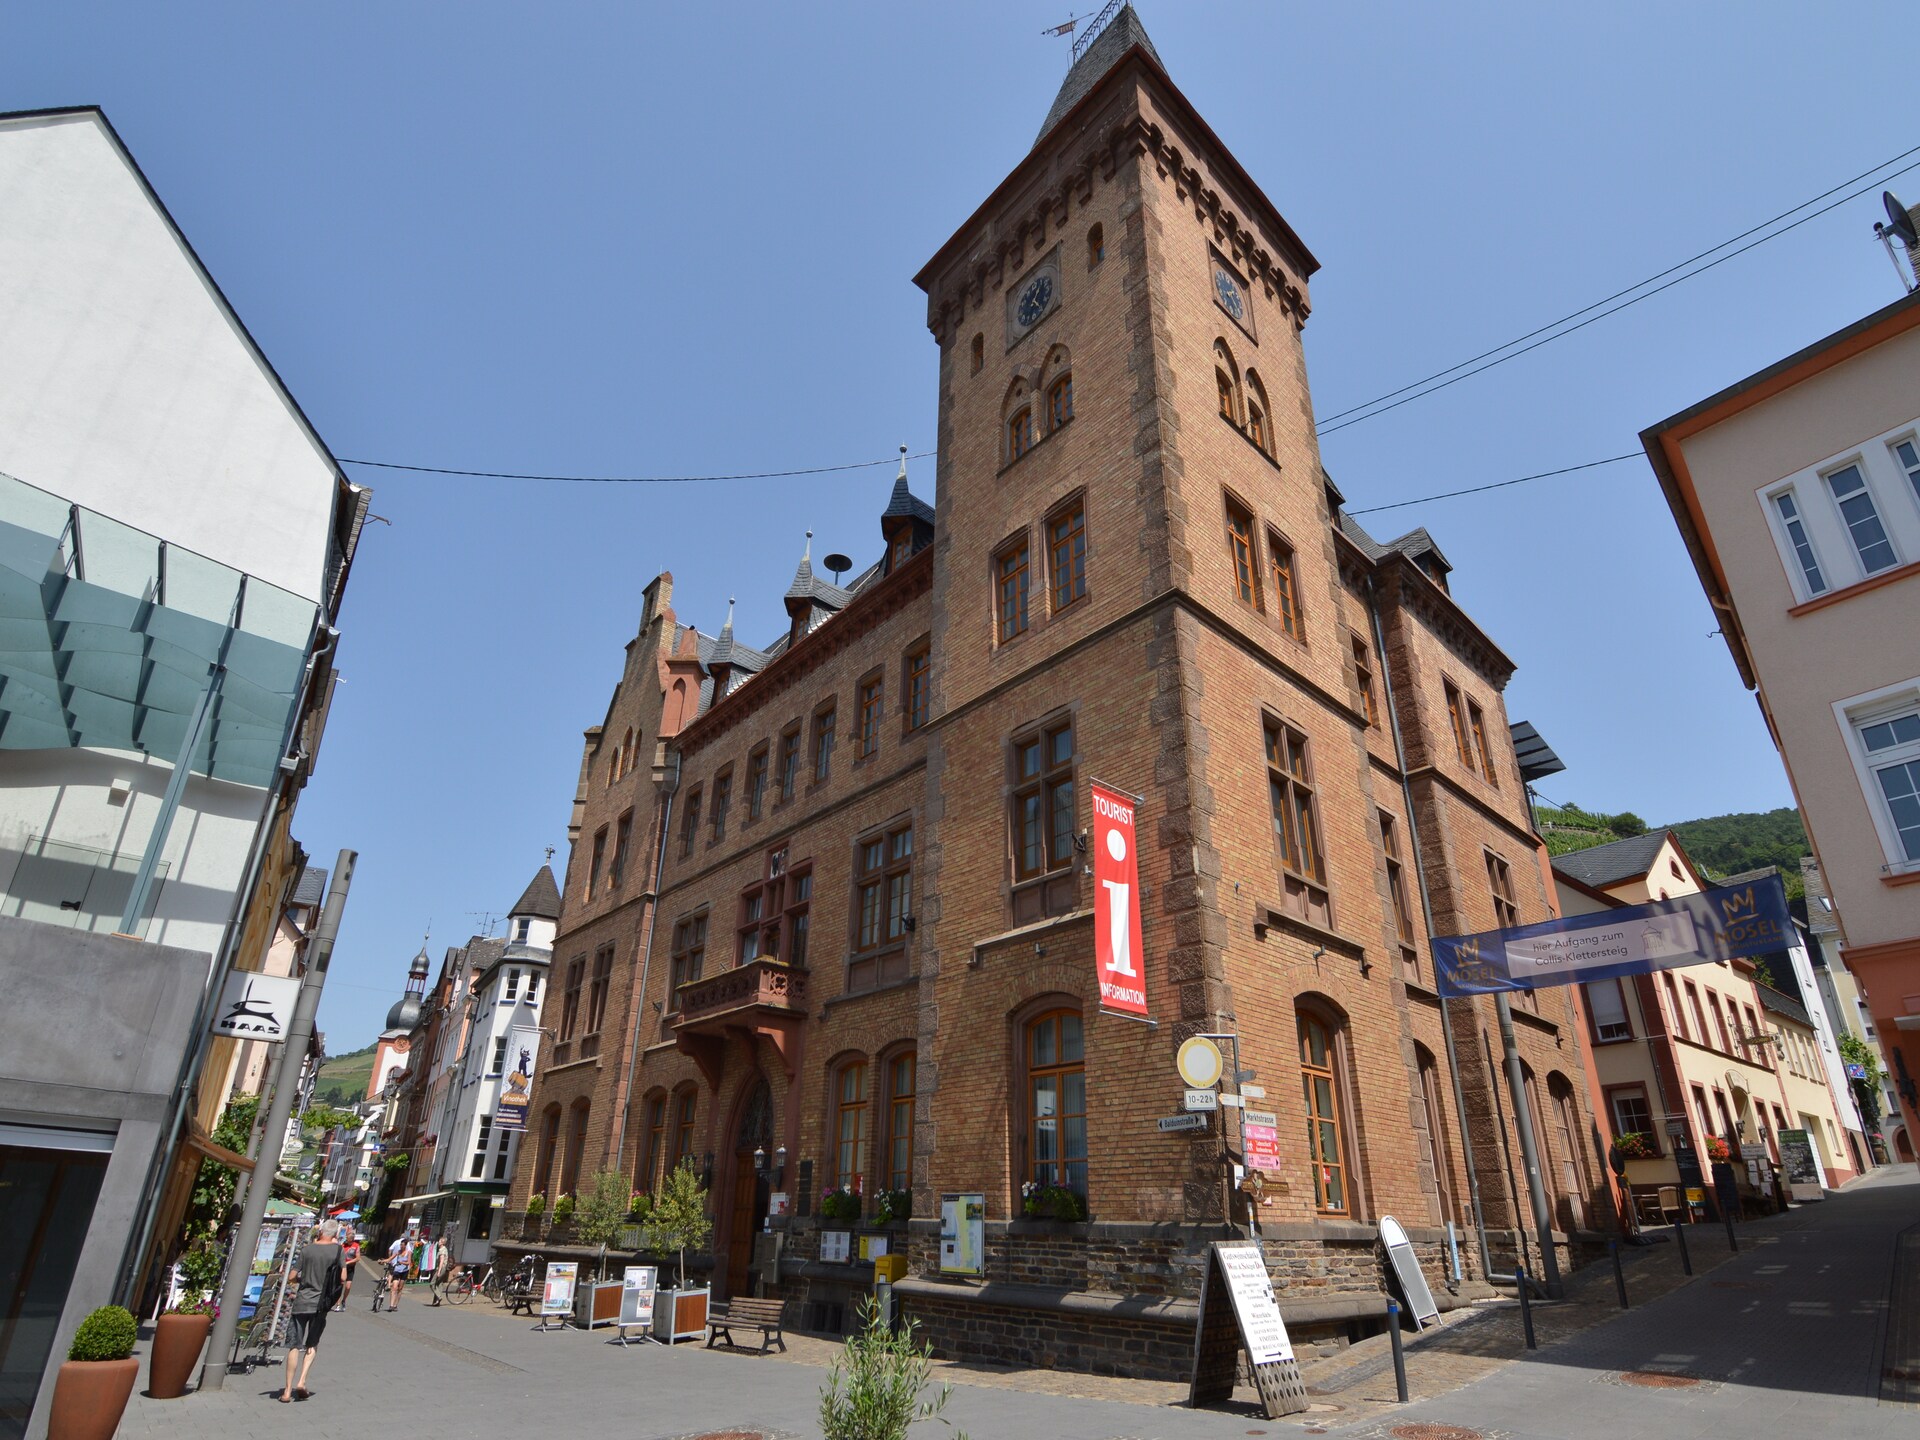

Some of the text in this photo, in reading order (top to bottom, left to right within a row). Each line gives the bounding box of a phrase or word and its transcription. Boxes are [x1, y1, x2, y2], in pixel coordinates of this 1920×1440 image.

[1093, 795, 1133, 826] TOURIST
[1713, 919, 1784, 945] MOSEL
[1532, 930, 1624, 953] hier Aufgang zum
[1535, 943, 1628, 966] Collis-Klettersteig
[1446, 966, 1497, 983] MOSEL
[1100, 981, 1145, 1006] INFORMATION
[220, 1020, 281, 1035] HAAS
[503, 1095, 526, 1103] Vinothek
[1187, 1095, 1214, 1104] 10-22h
[1164, 1116, 1194, 1128] Balduinstraße
[1245, 1111, 1274, 1124] Marktstrasse
